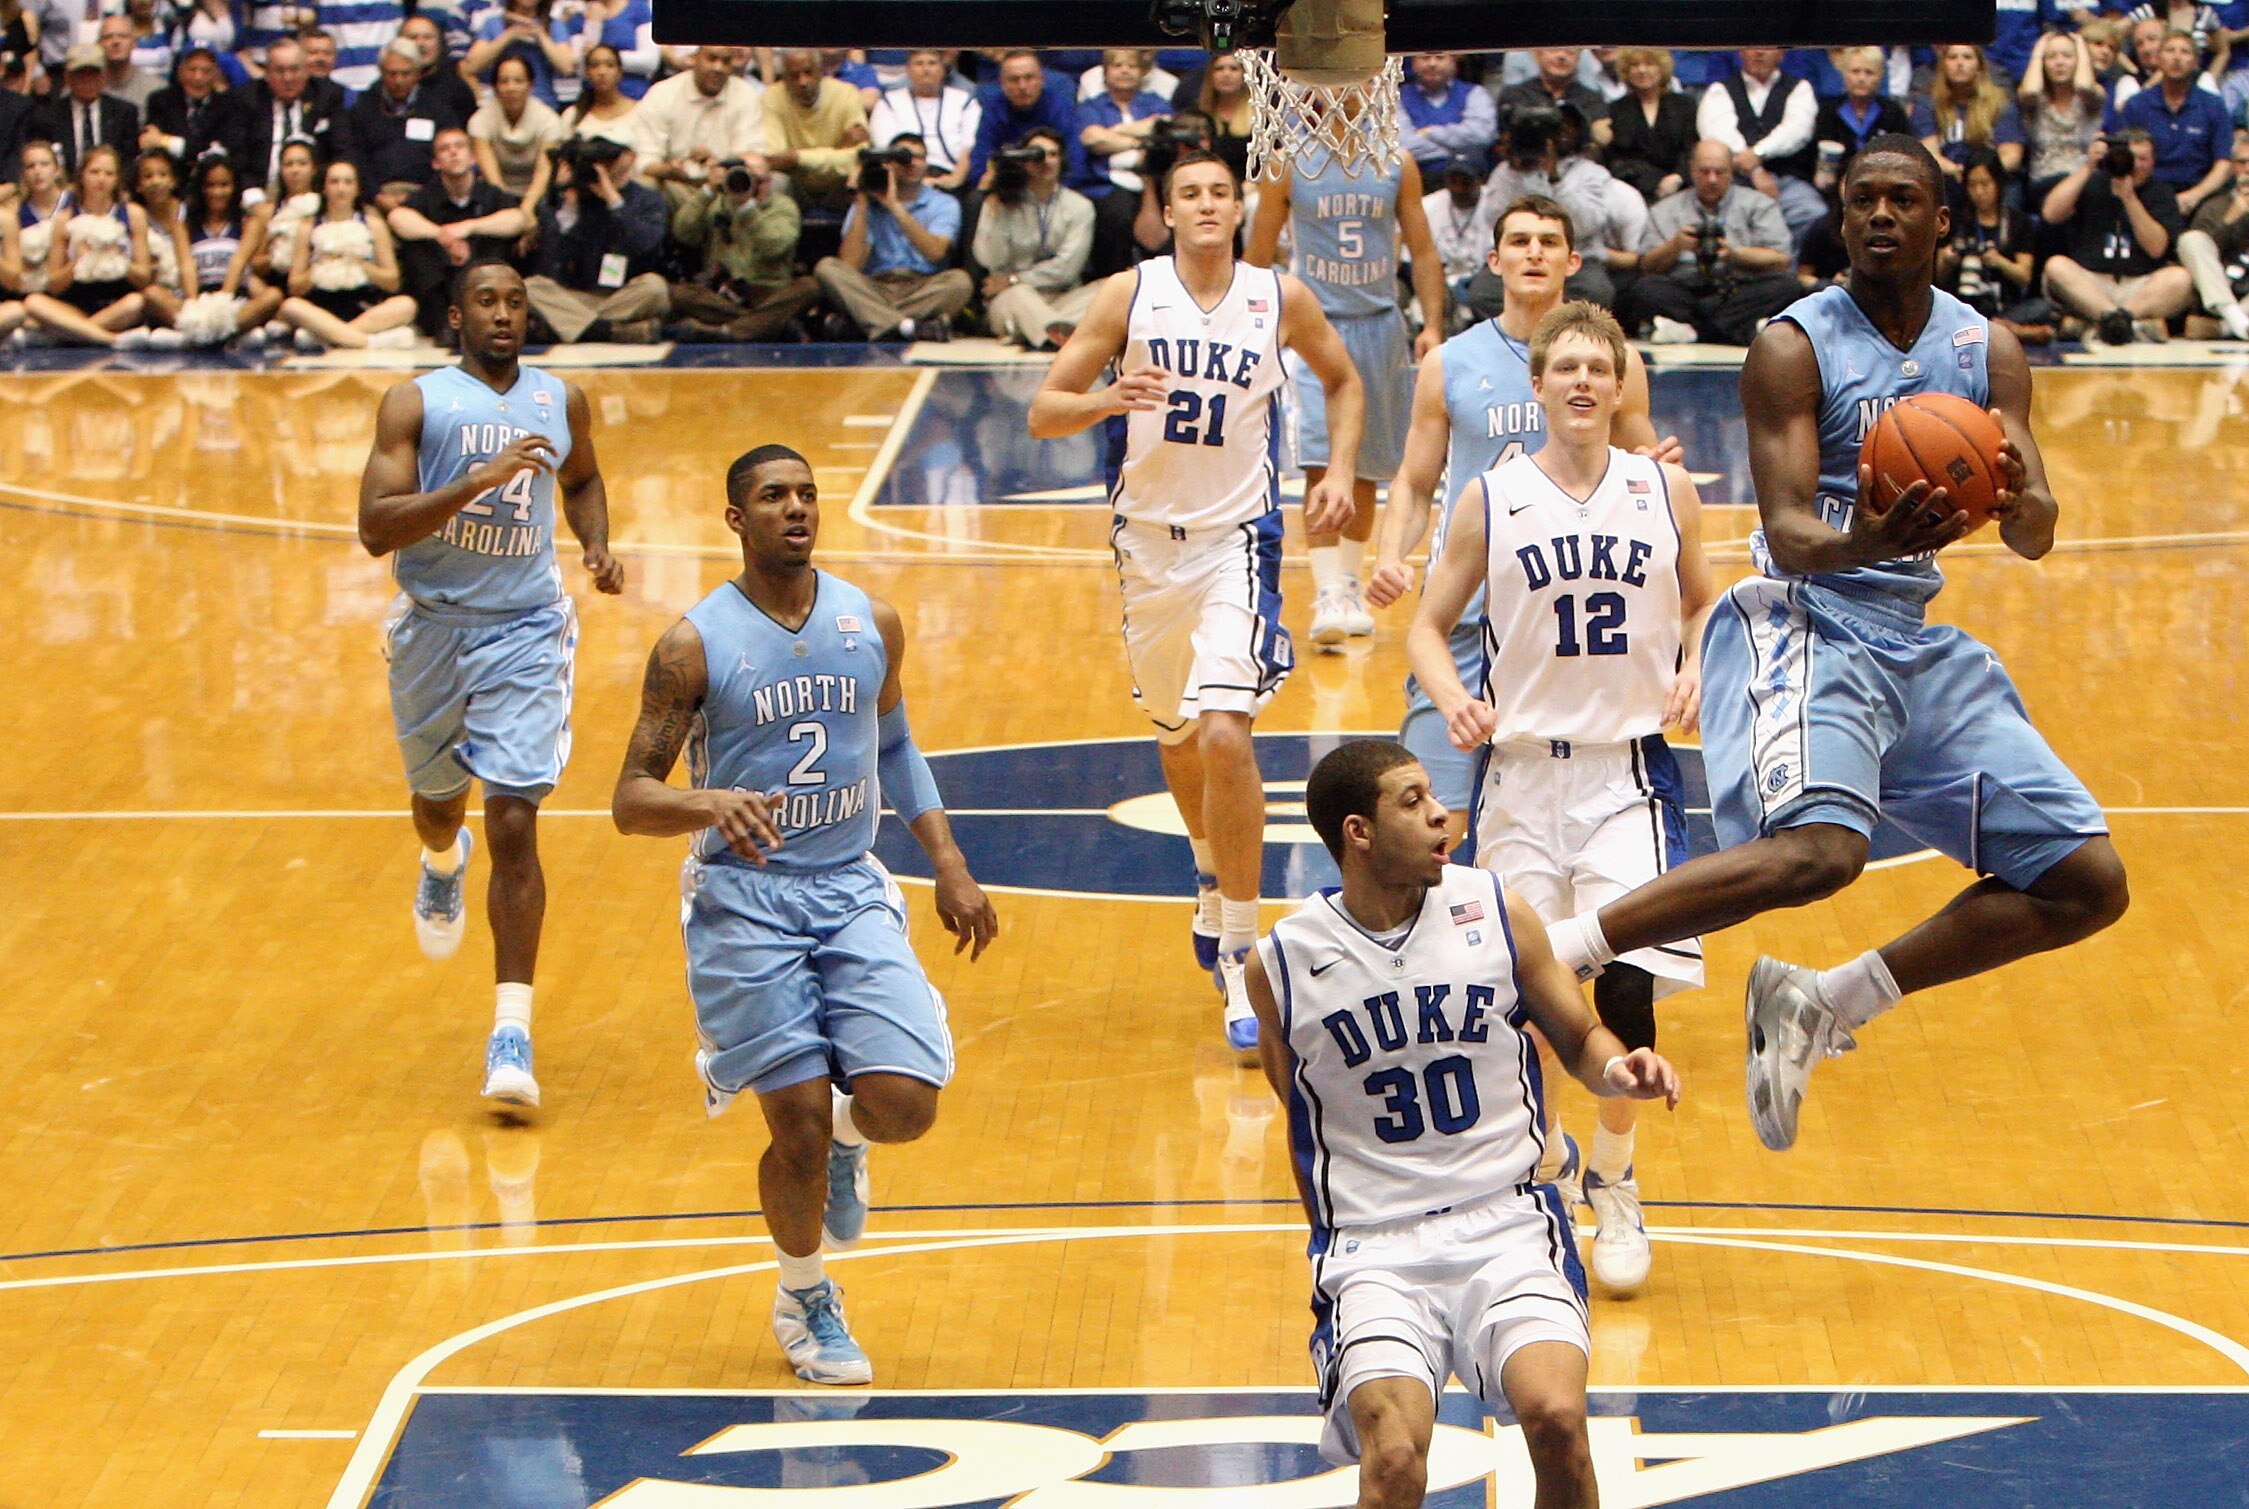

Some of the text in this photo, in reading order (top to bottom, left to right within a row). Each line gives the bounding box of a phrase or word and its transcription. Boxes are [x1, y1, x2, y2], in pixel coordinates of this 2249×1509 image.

[1317, 192, 1384, 218] NORTH
[1338, 220, 1364, 258] 5
[1148, 337, 1262, 390] DUKE
[1163, 389, 1227, 447] 21
[1486, 400, 1545, 438] NOR
[432, 516, 543, 558] AROLINA
[1515, 533, 1653, 592] DUKE
[1553, 591, 1628, 658] 12
[752, 672, 857, 727] NORTH
[786, 720, 829, 786] 2
[731, 776, 868, 830] ROLINA
[1321, 983, 1496, 1069] DUKE
[1363, 1054, 1481, 1144] 30
